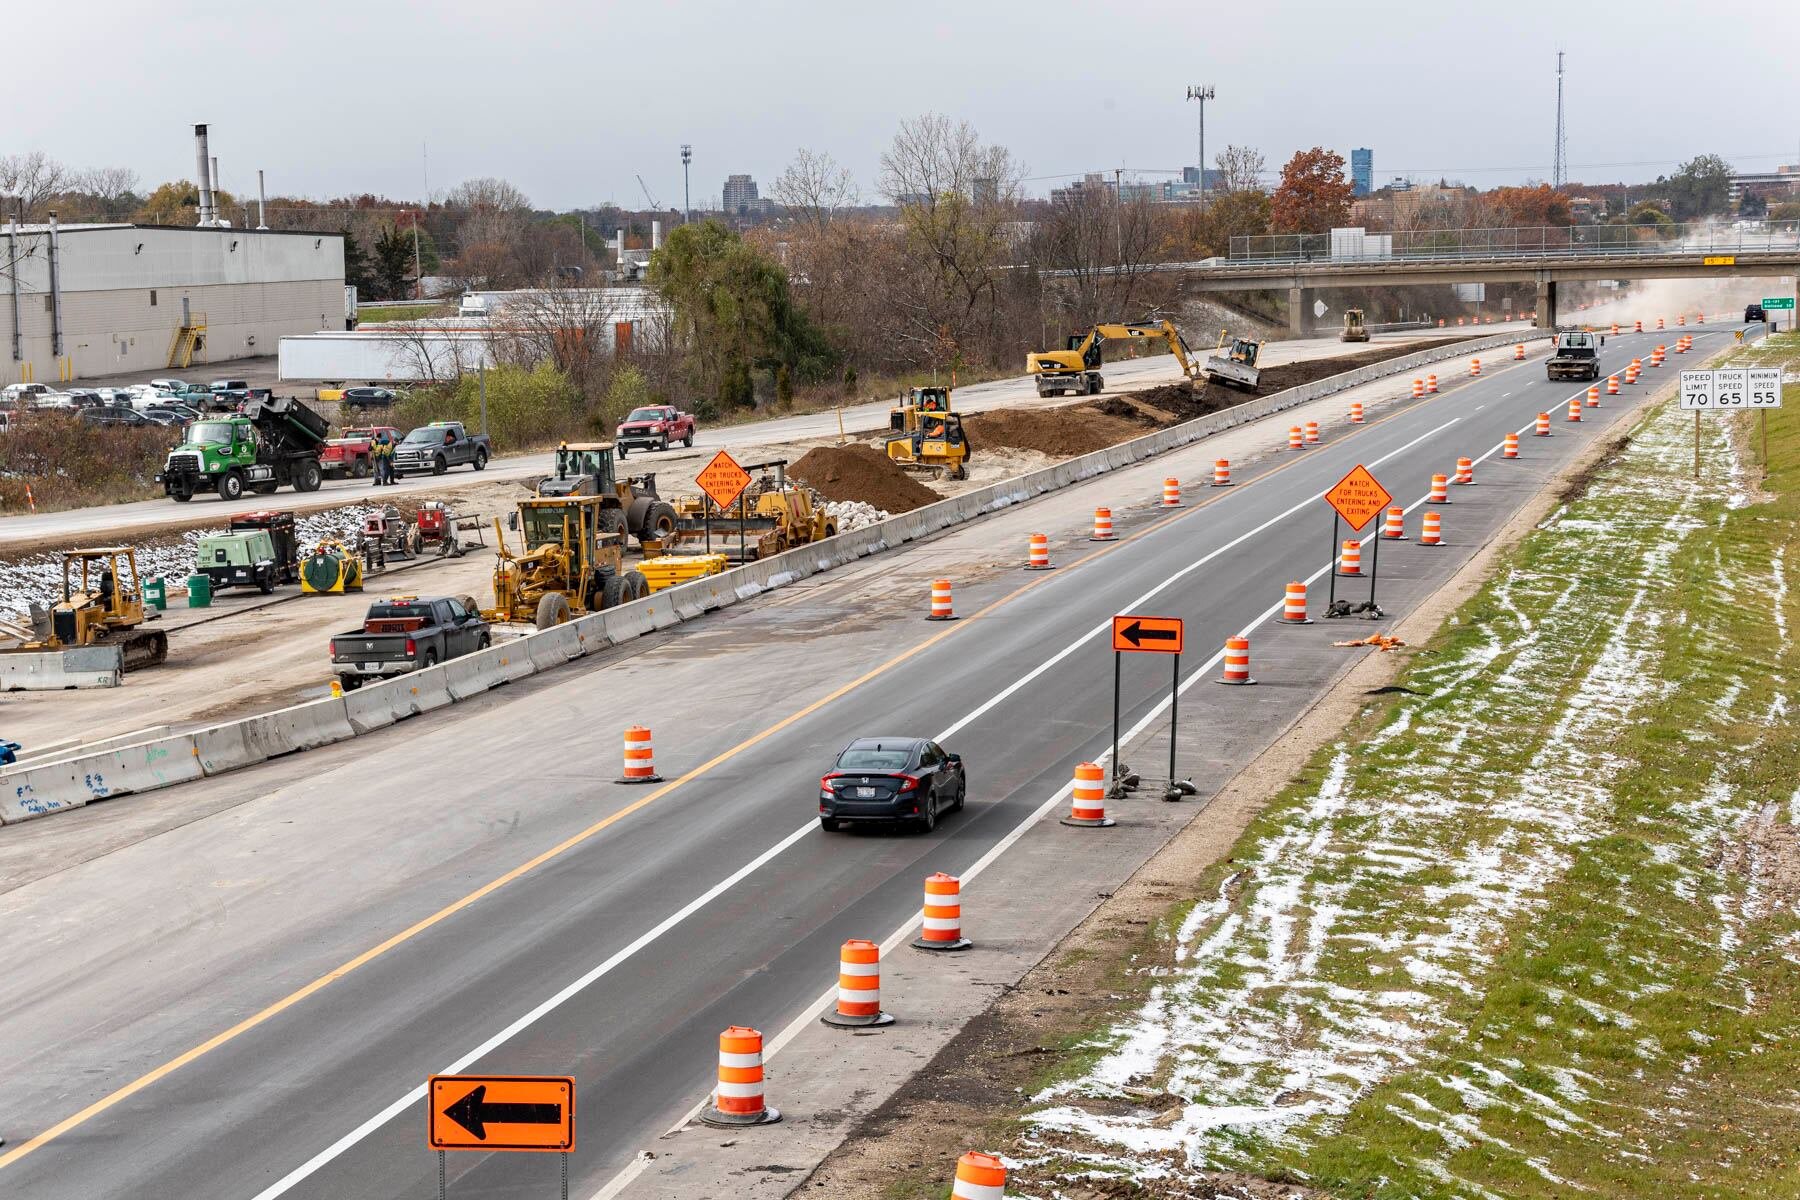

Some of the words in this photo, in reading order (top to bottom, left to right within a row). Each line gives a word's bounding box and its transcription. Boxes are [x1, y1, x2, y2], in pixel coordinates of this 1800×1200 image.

[1685, 383, 1707, 391] LIMIT
[1686, 393, 1708, 406] 70
[1719, 392, 1742, 405] 65
[1753, 391, 1775, 404] 55
[713, 461, 733, 469] WATCH
[719, 471, 743, 479] TRUCKS
[1354, 489, 1378, 497] TRUCKS
[1336, 497, 1366, 506] ENTERING
[1346, 507, 1370, 515] EXITING
